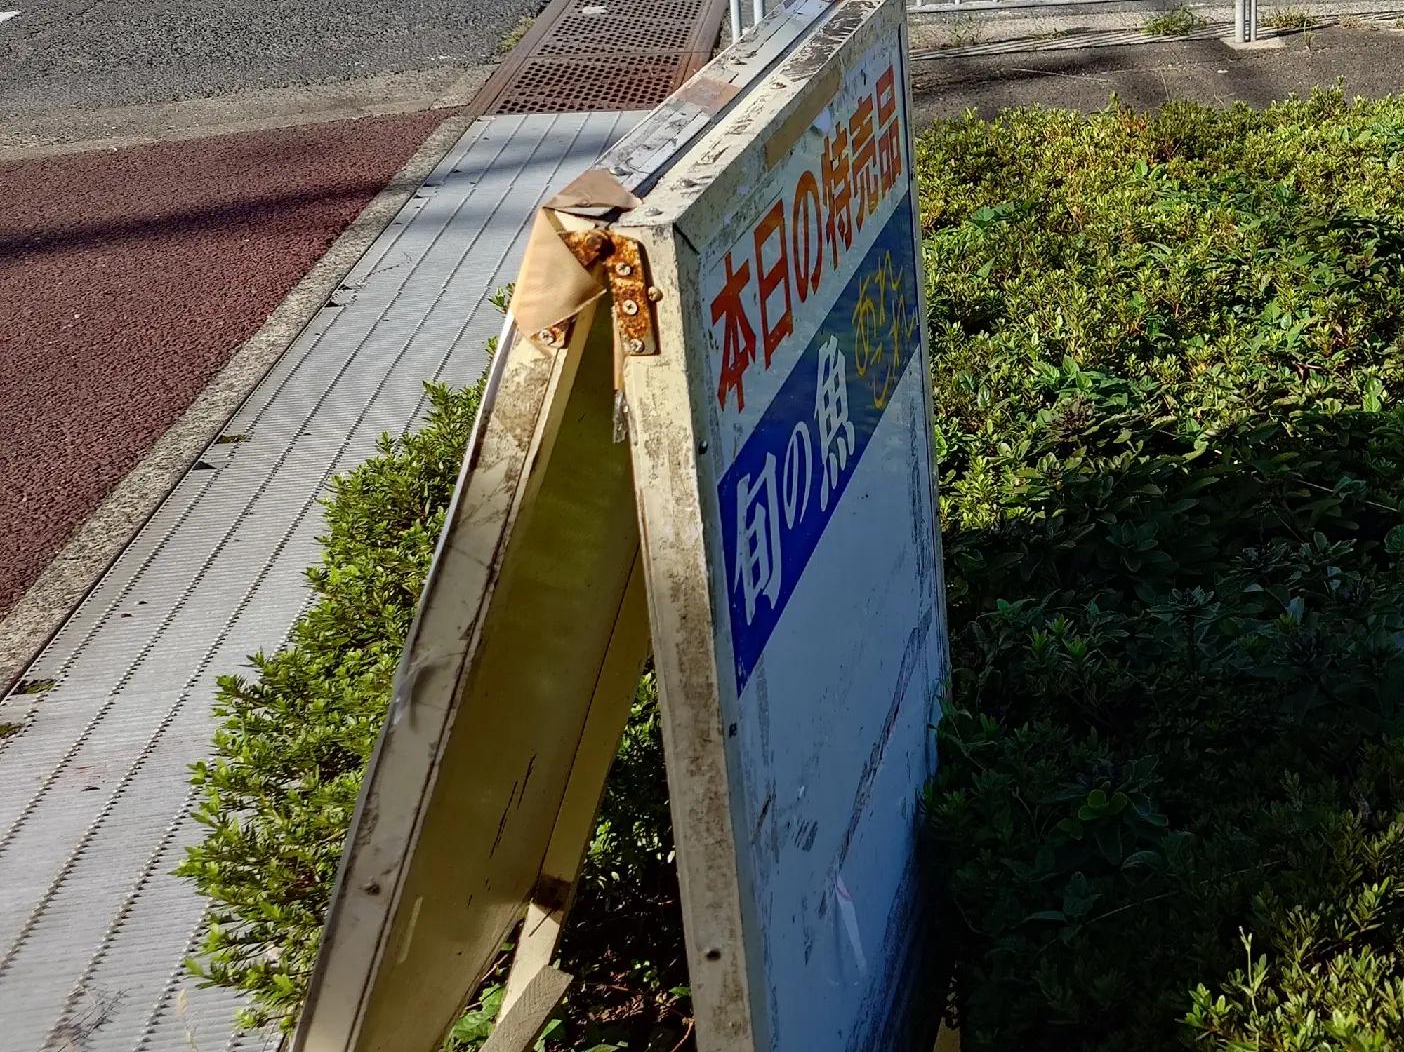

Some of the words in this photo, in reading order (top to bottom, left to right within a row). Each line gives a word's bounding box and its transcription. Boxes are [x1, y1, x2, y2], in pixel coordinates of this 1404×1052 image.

[711, 64, 902, 414] 本日の特売品
[733, 334, 855, 626] 旬の魚
